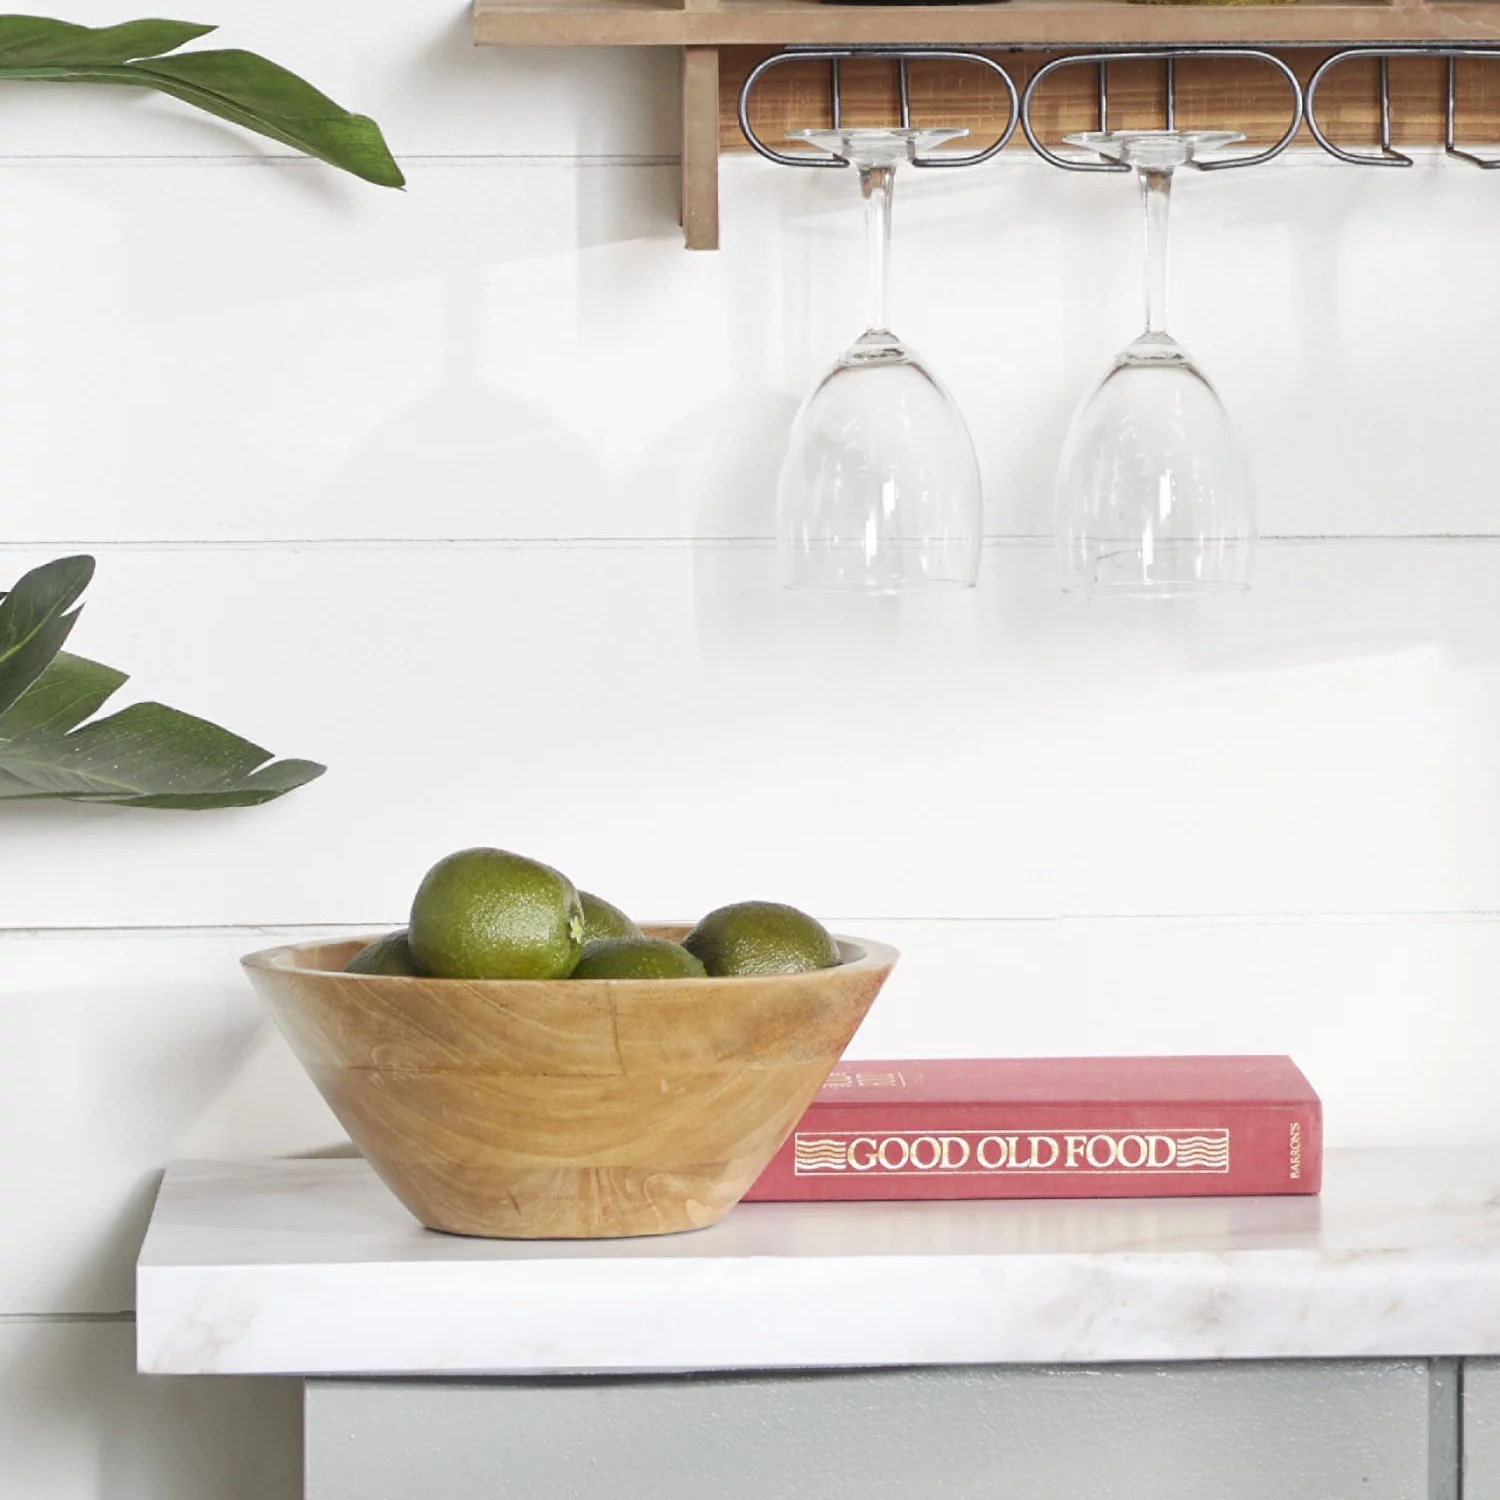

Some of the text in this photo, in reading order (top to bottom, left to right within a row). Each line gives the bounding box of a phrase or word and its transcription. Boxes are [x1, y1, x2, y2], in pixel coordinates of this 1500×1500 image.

[846, 1134, 1177, 1171] GOOD OLD FOOD
[1289, 1122, 1301, 1179] BARRON'S
